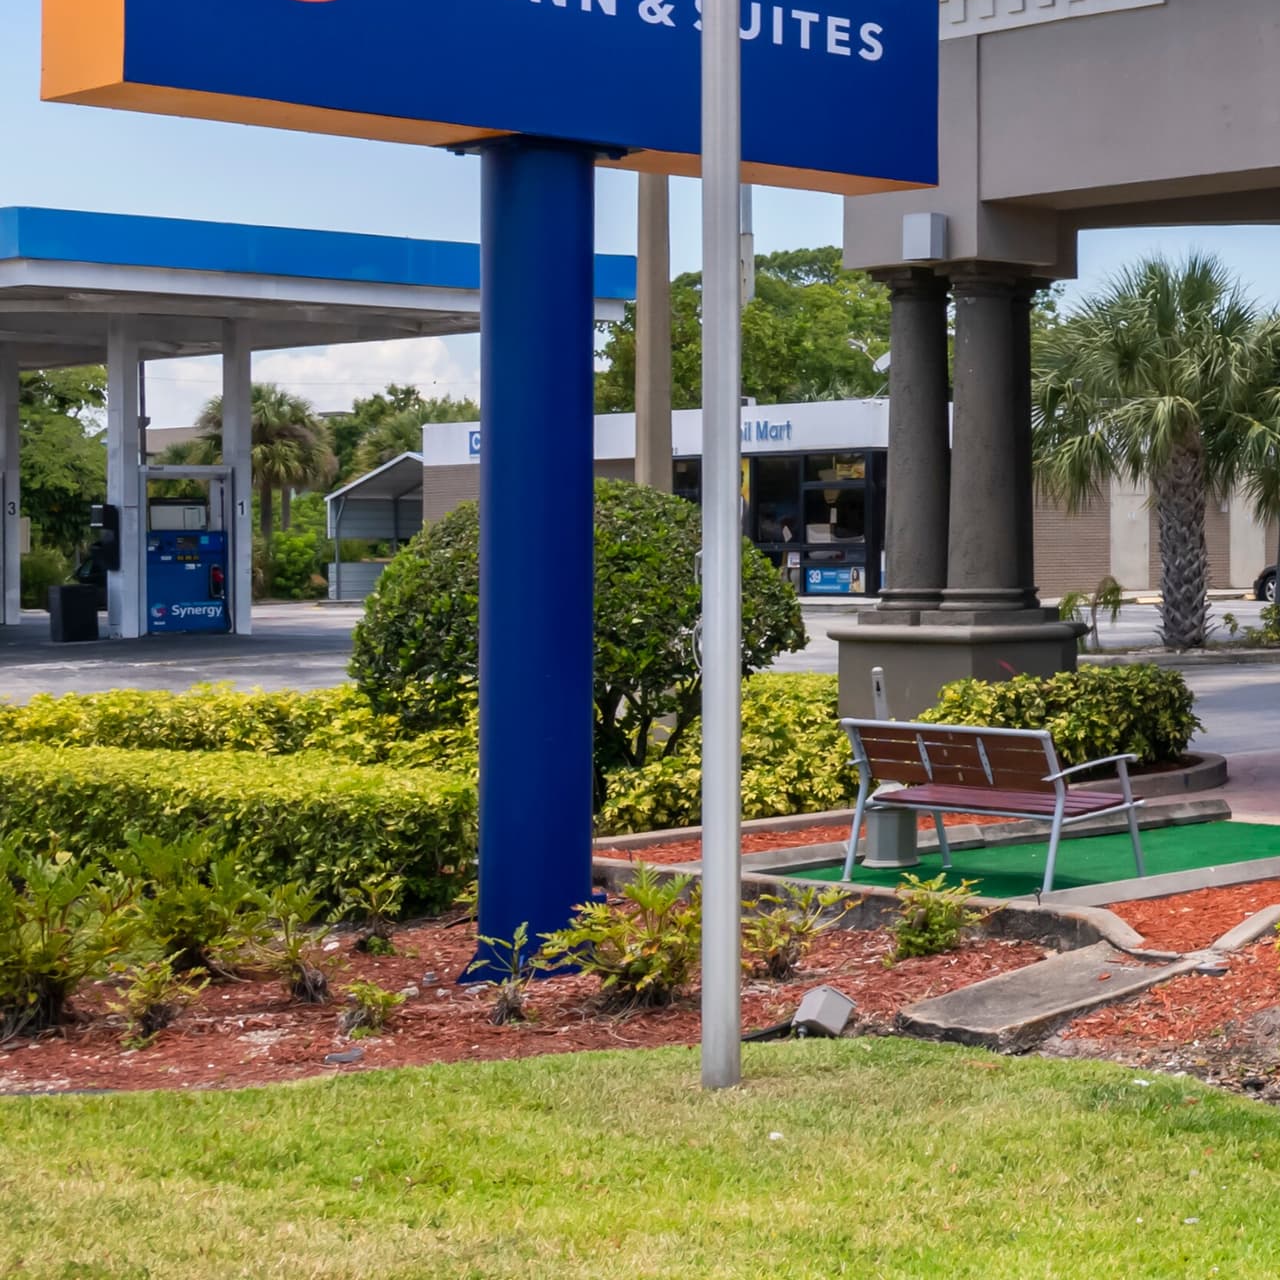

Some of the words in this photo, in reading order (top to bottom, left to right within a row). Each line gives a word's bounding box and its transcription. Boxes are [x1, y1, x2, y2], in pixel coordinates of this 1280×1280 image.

[756, 420, 792, 441] Mart
[8, 501, 16, 515] 3
[238, 501, 245, 515] 1
[171, 604, 223, 619] Synergy
